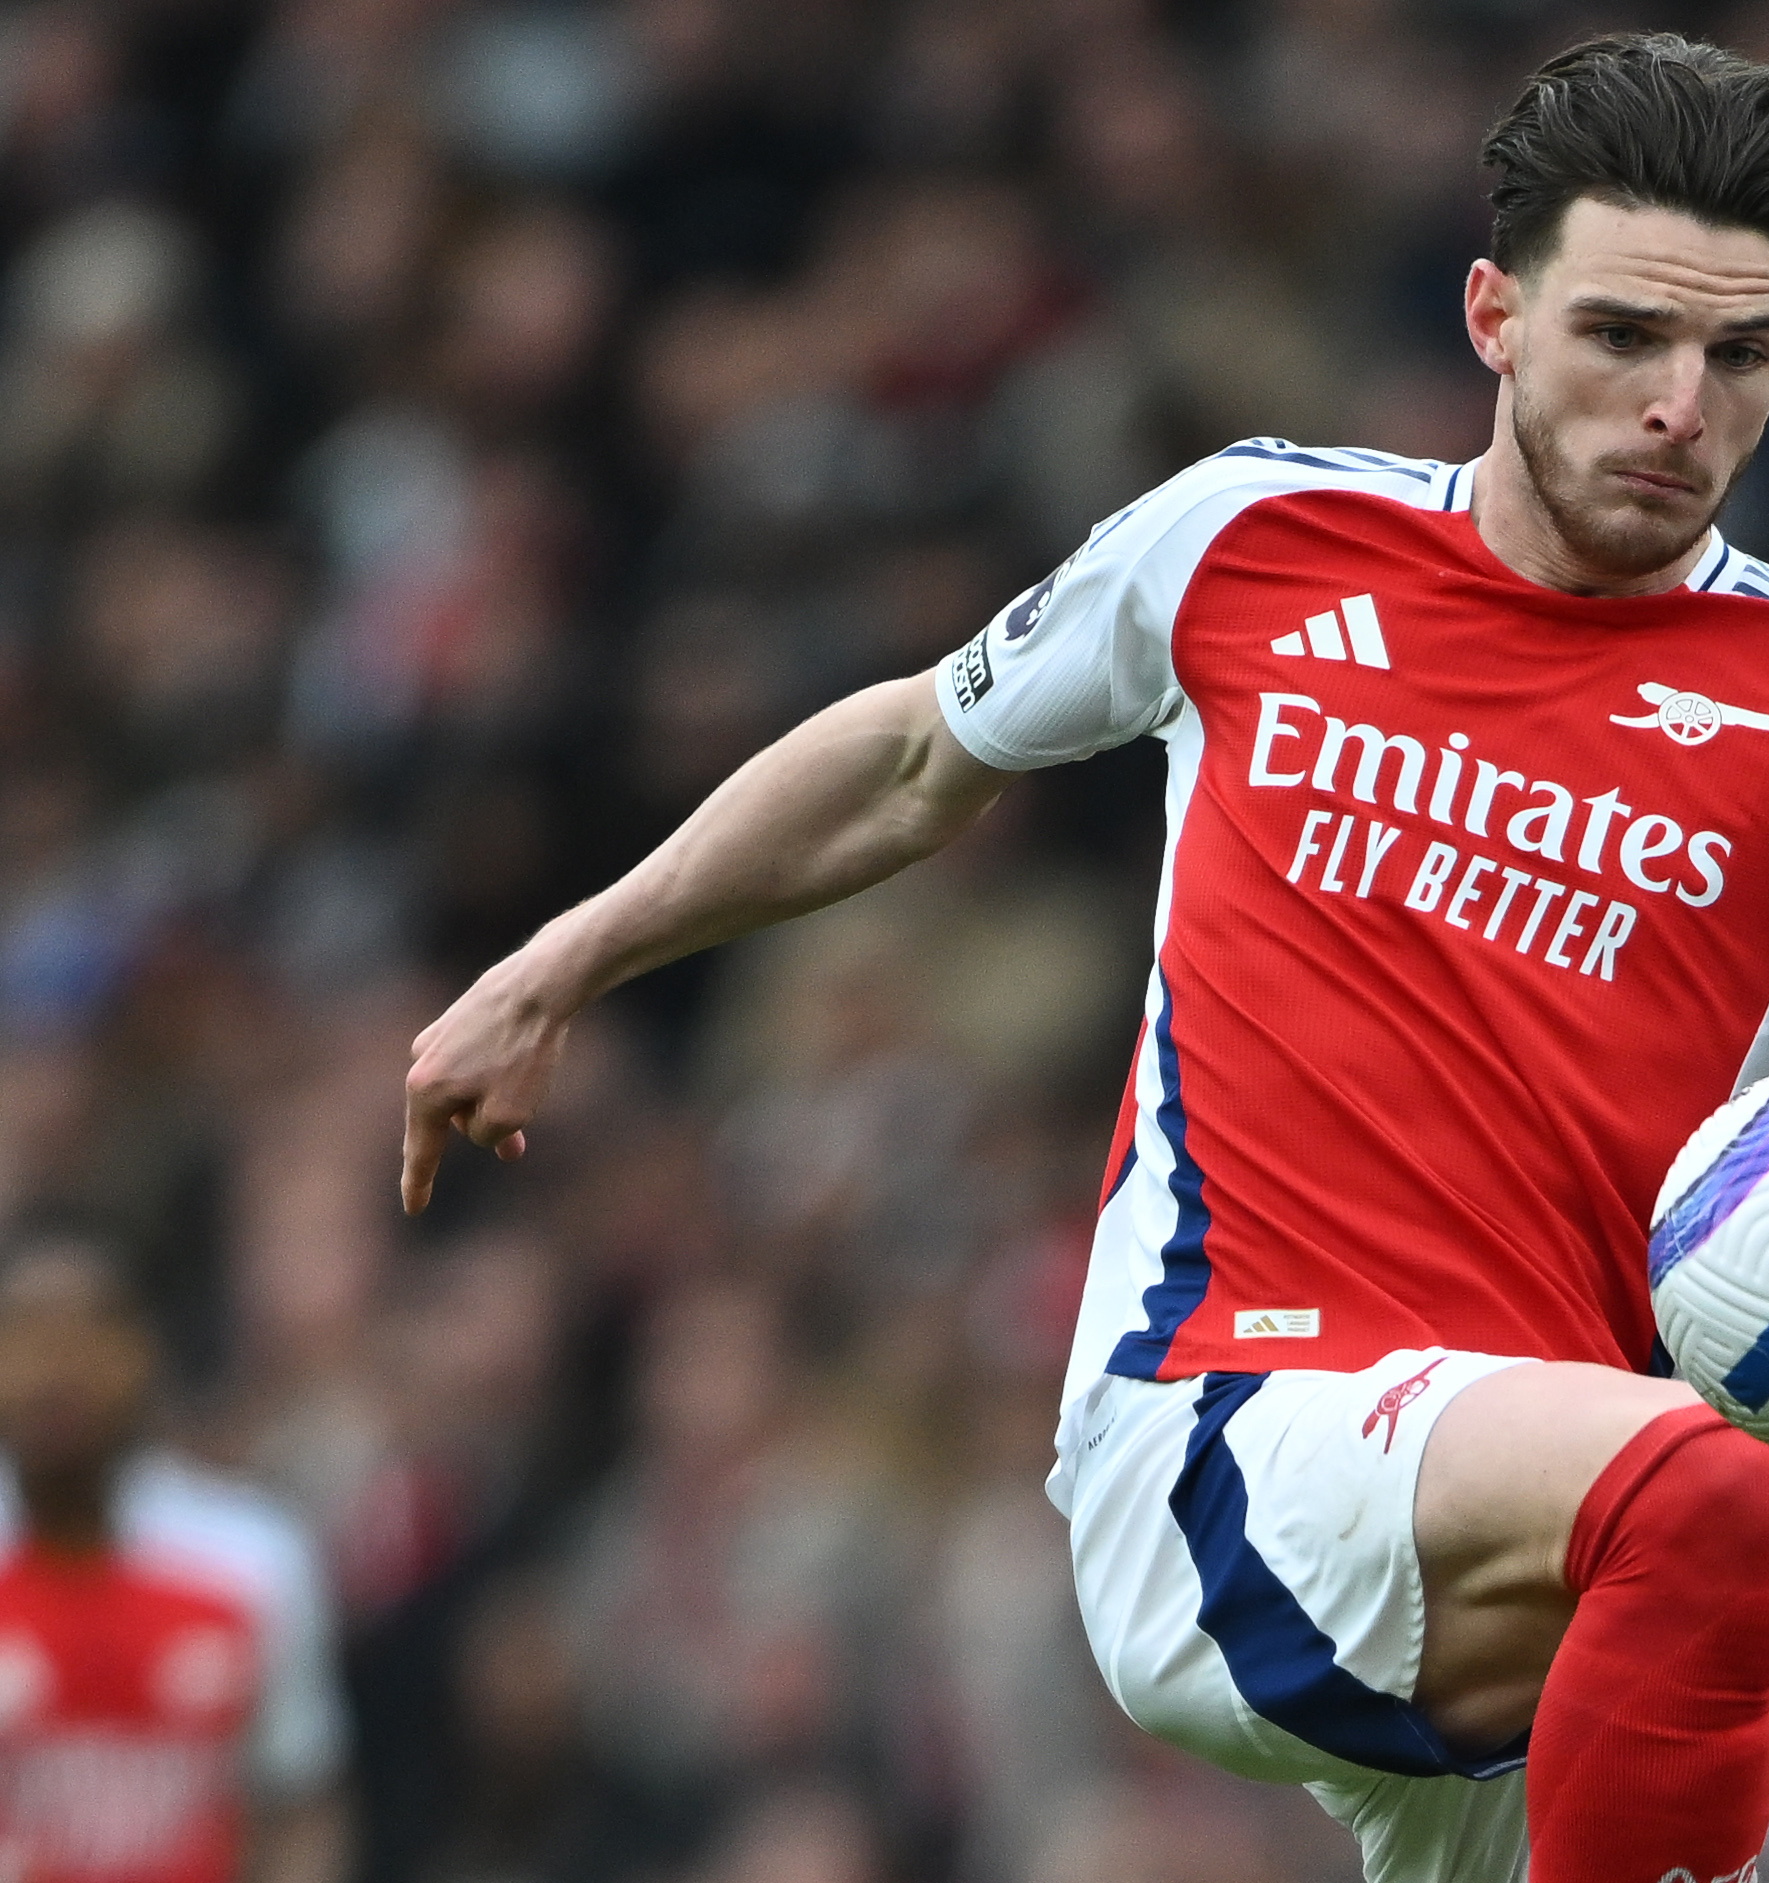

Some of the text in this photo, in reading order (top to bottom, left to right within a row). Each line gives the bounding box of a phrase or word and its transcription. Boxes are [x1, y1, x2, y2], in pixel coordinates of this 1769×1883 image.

[1248, 692, 1732, 907] Emirates
[1286, 809, 1638, 982] FLY BETTER
